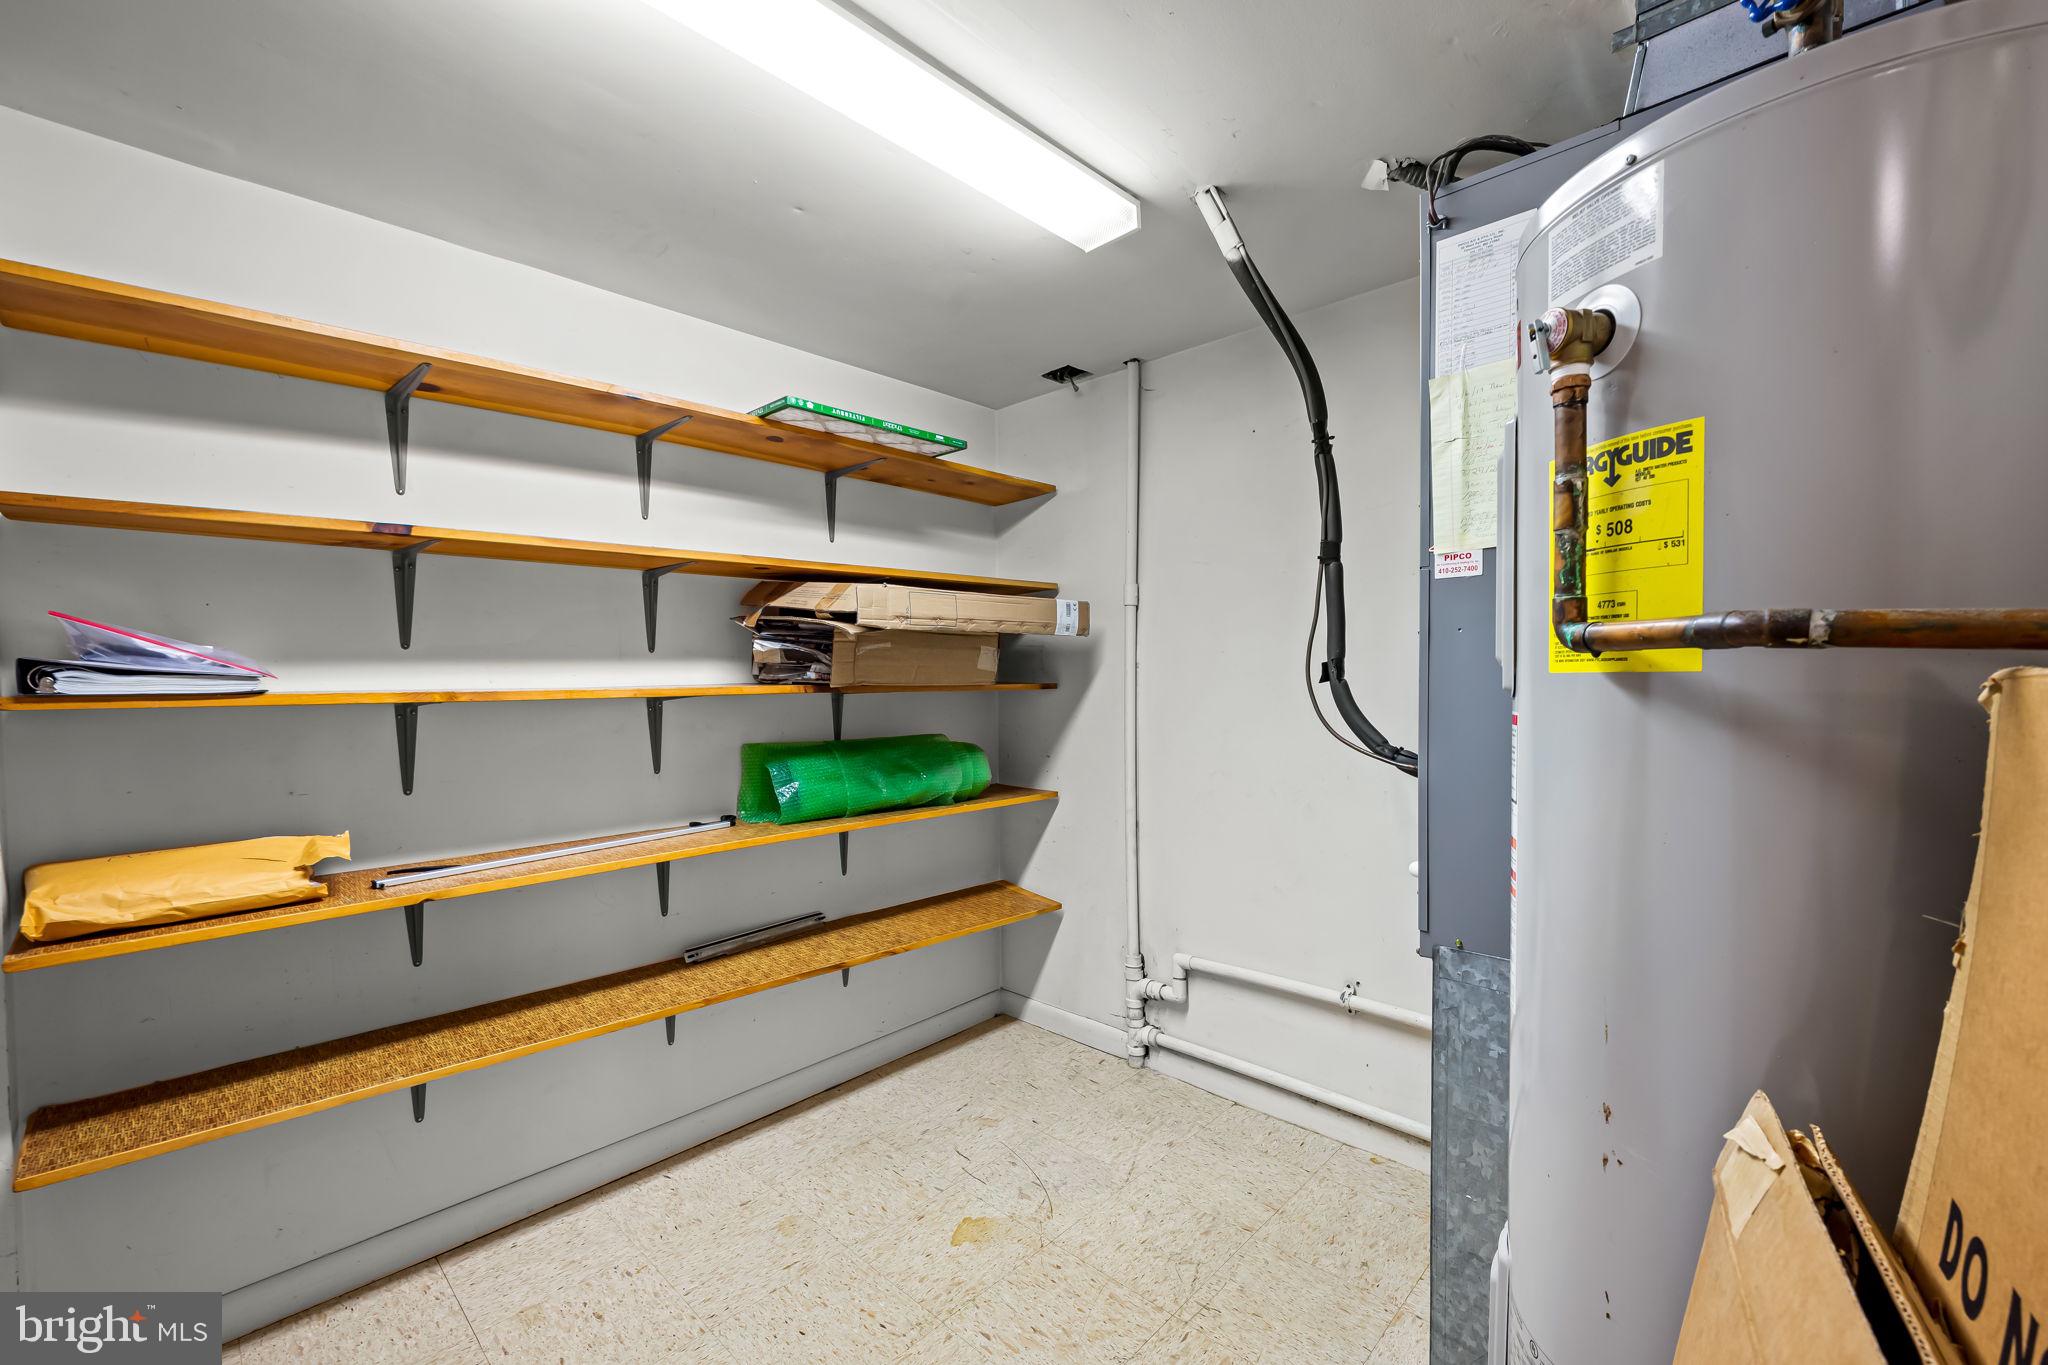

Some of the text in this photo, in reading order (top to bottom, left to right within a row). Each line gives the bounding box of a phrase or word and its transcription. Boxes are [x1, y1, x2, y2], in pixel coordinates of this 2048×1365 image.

[832, 408, 866, 422] FILTERBUY
[1609, 502, 1635, 513] OPERATING
[1635, 499, 1652, 508] COSTS
[1596, 518, 1633, 538] $ 508
[1664, 539, 1685, 549] $ 531
[1444, 552, 1472, 561] PIPCO
[1438, 564, 1479, 574] 410-252-7400
[1597, 599, 1616, 609] 4773
[1939, 1197, 2048, 1365] DO N
